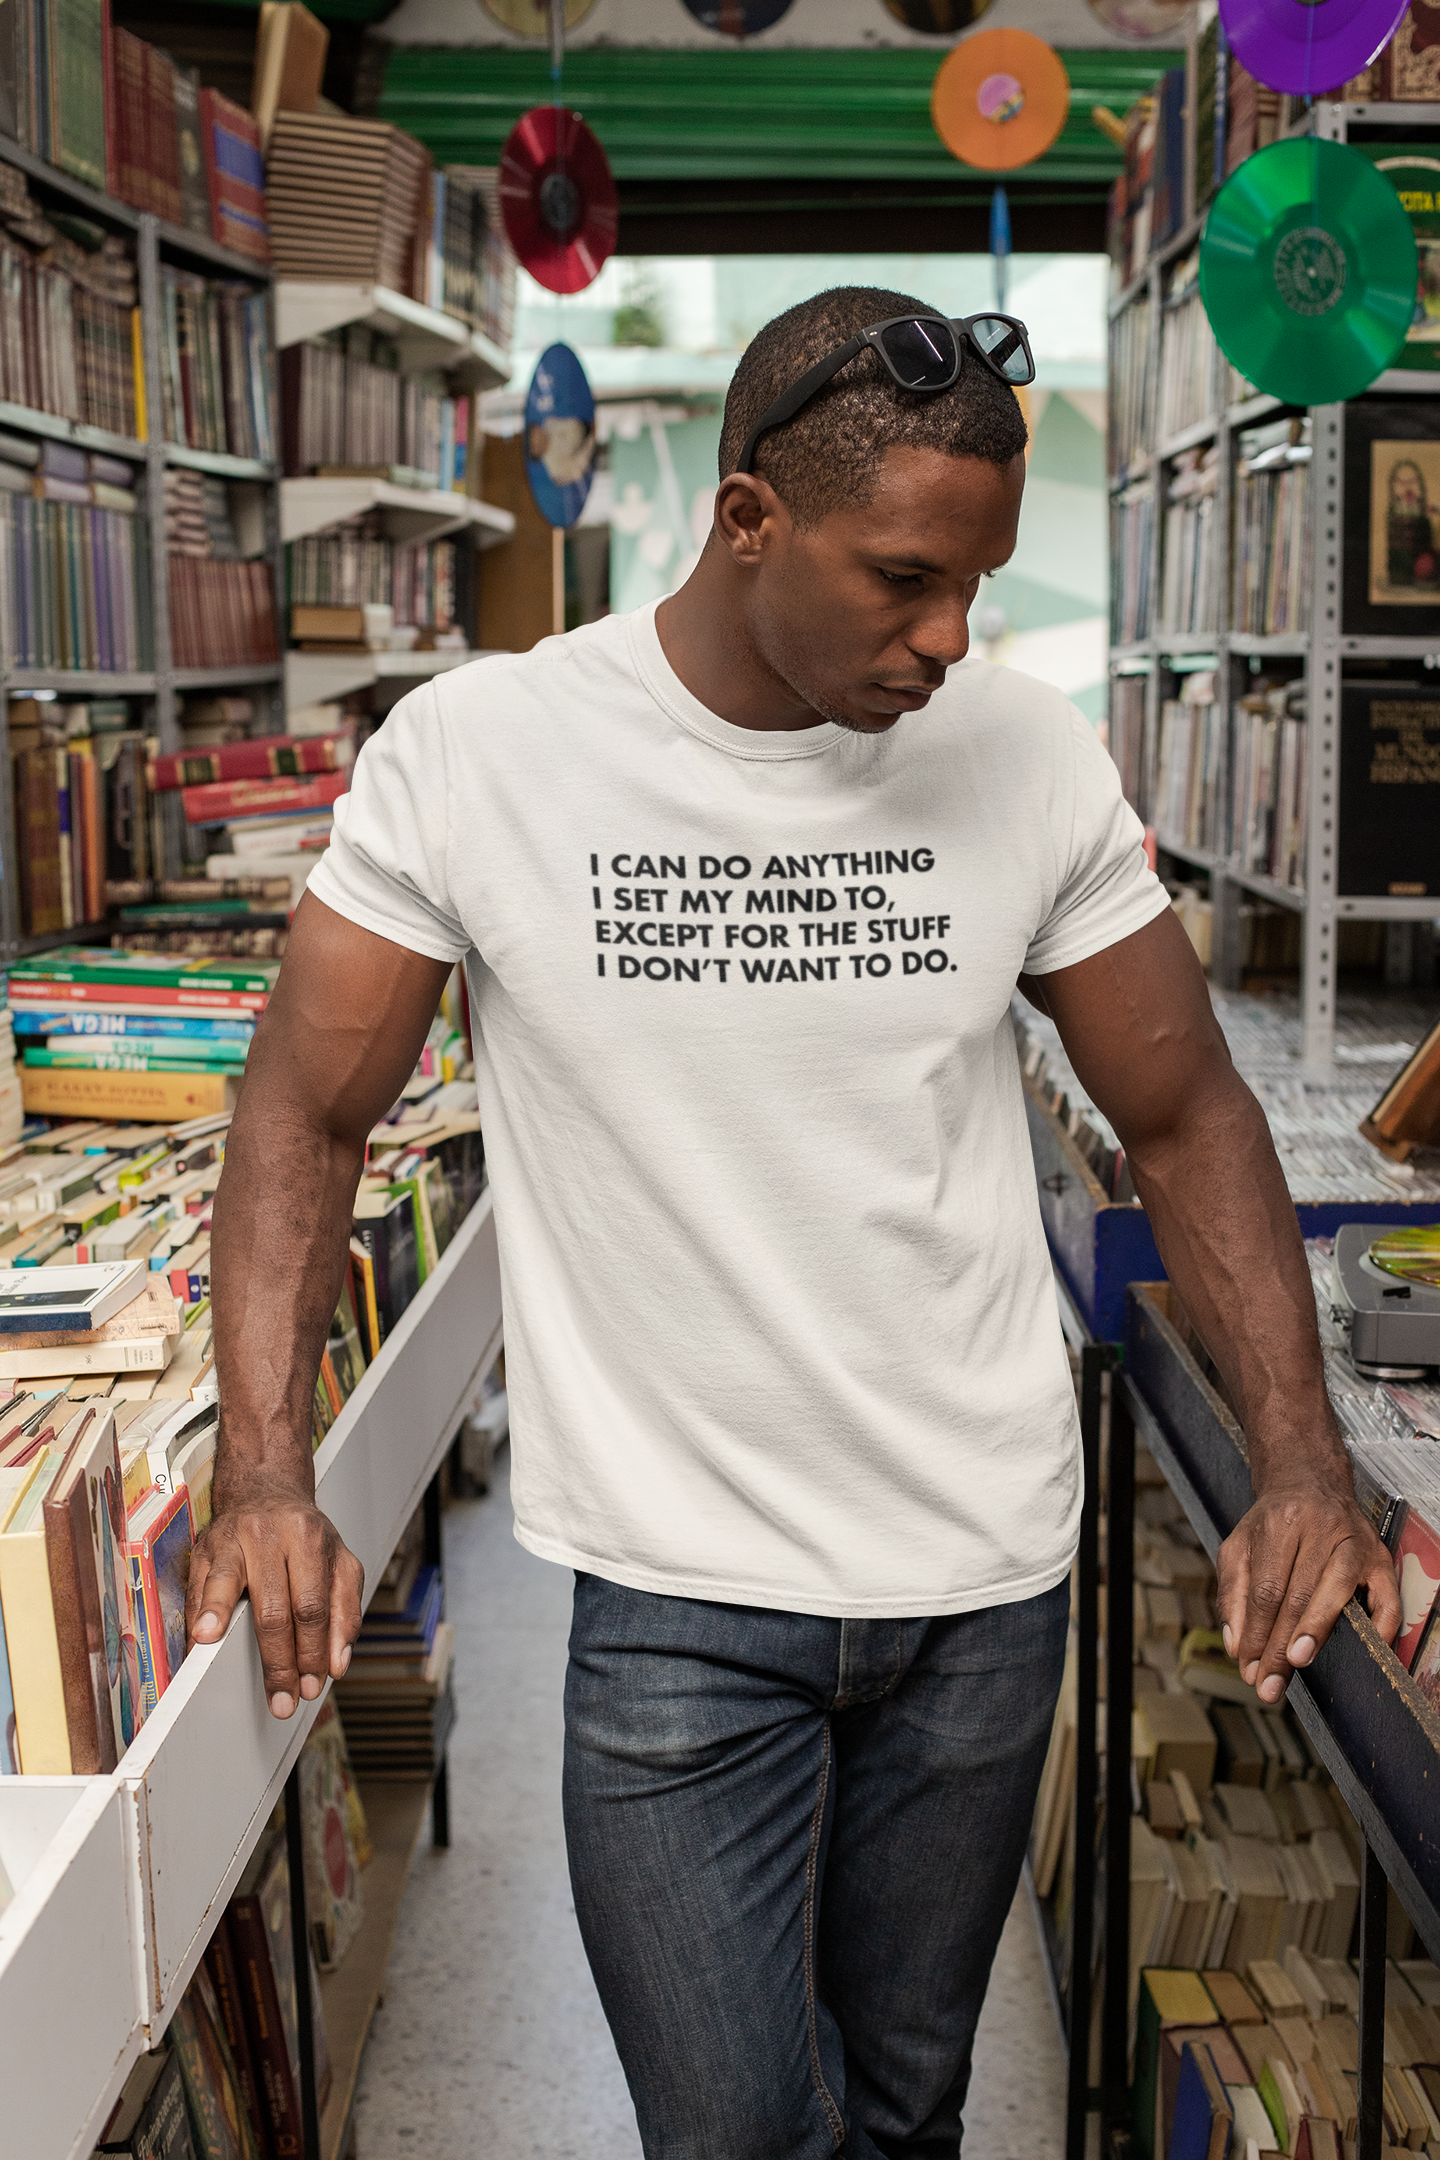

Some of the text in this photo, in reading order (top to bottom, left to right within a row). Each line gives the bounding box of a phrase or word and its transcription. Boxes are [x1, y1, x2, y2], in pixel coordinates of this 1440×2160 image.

[591, 848, 934, 879] I CAN DO ANYTHING
[593, 886, 894, 913] I SET MY MIND TO,
[596, 915, 950, 948] EXCEPT FOR THE STUFF
[598, 949, 957, 983] I DON’T WANT TO DO.
